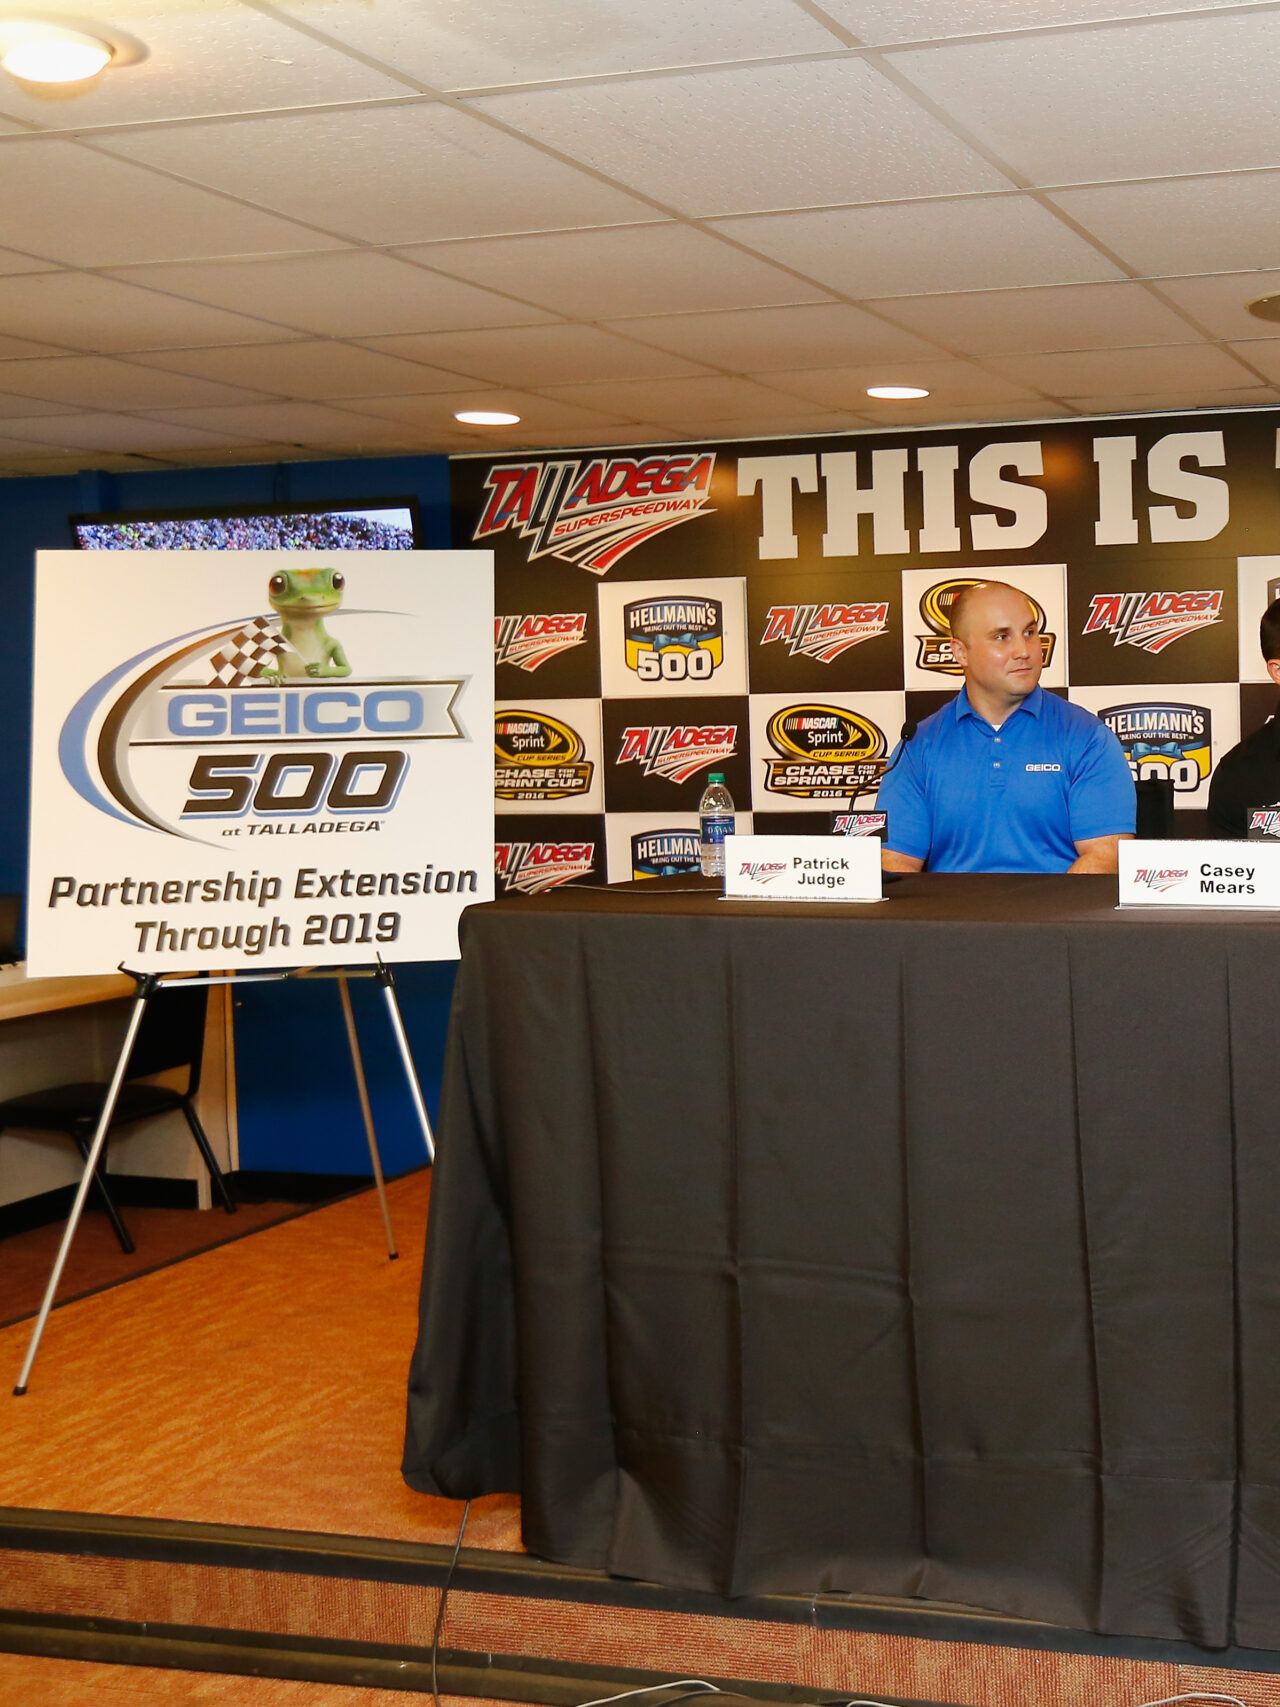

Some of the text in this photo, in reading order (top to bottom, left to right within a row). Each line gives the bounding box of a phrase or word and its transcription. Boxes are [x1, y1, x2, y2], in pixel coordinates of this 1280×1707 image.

[476, 455, 714, 552] TALLADEGA
[737, 440, 1048, 560] THIS
[1092, 430, 1230, 546] IS
[552, 497, 704, 537] SUPERSPEEDWAY
[630, 602, 717, 629] HELLMANN'S
[1084, 591, 1222, 642] TALLADEGA
[1129, 613, 1215, 633] SUPERSPEEDWAY
[762, 603, 888, 650] TALLADEGA
[495, 614, 586, 660] LLADEGA
[637, 649, 713, 681] 500
[167, 689, 425, 737] GEICO
[1104, 709, 1205, 735] HELLMANN'S
[507, 722, 540, 735] NASCAR
[801, 717, 838, 730] NASCAR
[512, 735, 545, 751] Sprint
[807, 730, 844, 747] Sprint
[618, 726, 736, 771] TALLADEGA
[495, 768, 556, 779] CHASE
[785, 765, 856, 776] CHASE
[1025, 763, 1061, 772] GEICO
[178, 749, 411, 820] 500
[495, 778, 584, 788] PRINT CUP
[773, 776, 843, 786] SPRINT
[517, 792, 545, 800] 2016
[221, 820, 381, 837] at TALLADEGA
[637, 837, 702, 860] HELLMAN
[495, 843, 593, 888] ALLADEGA
[739, 862, 787, 880] TALLADEGA
[793, 857, 849, 871] Patrick
[1200, 863, 1256, 881] Casey
[48, 864, 478, 908] Partnership Extension
[798, 872, 846, 889] Judge
[1134, 869, 1188, 888] TALLADEGA
[1200, 880, 1256, 894] Mears
[134, 912, 401, 955] Through 2019
